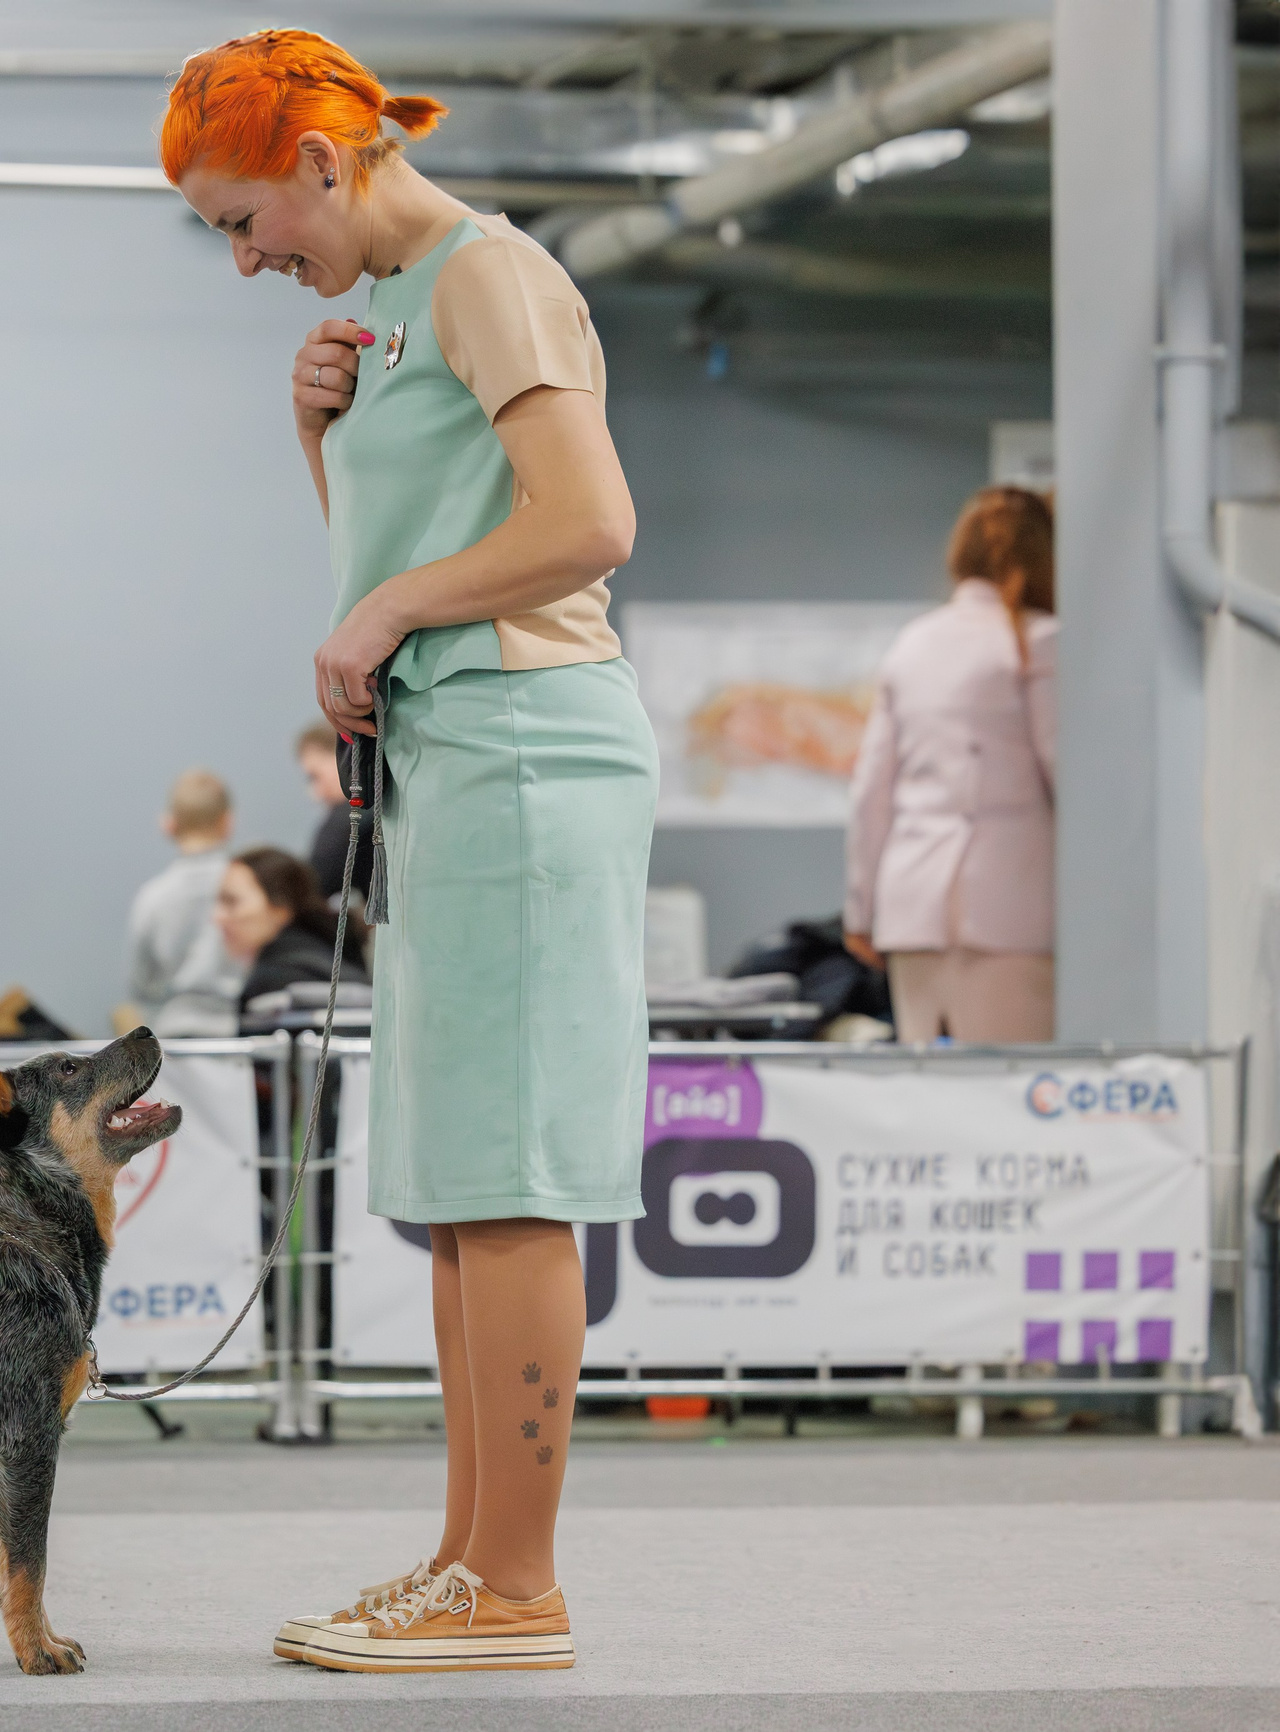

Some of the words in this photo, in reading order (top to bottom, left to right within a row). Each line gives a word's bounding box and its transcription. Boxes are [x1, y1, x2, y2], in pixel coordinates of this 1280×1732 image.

[1026, 1072, 1178, 1119] СФЕРА
[837, 1153, 949, 1190] СУХИЕ
[976, 1153, 1089, 1189] КОРМА
[836, 1199, 905, 1238] ДЛЯ
[930, 1200, 1042, 1233] КОШЕК
[837, 1244, 859, 1277] И
[883, 1243, 997, 1278] СОБАК
[97, 1282, 226, 1322] ФЕРА
